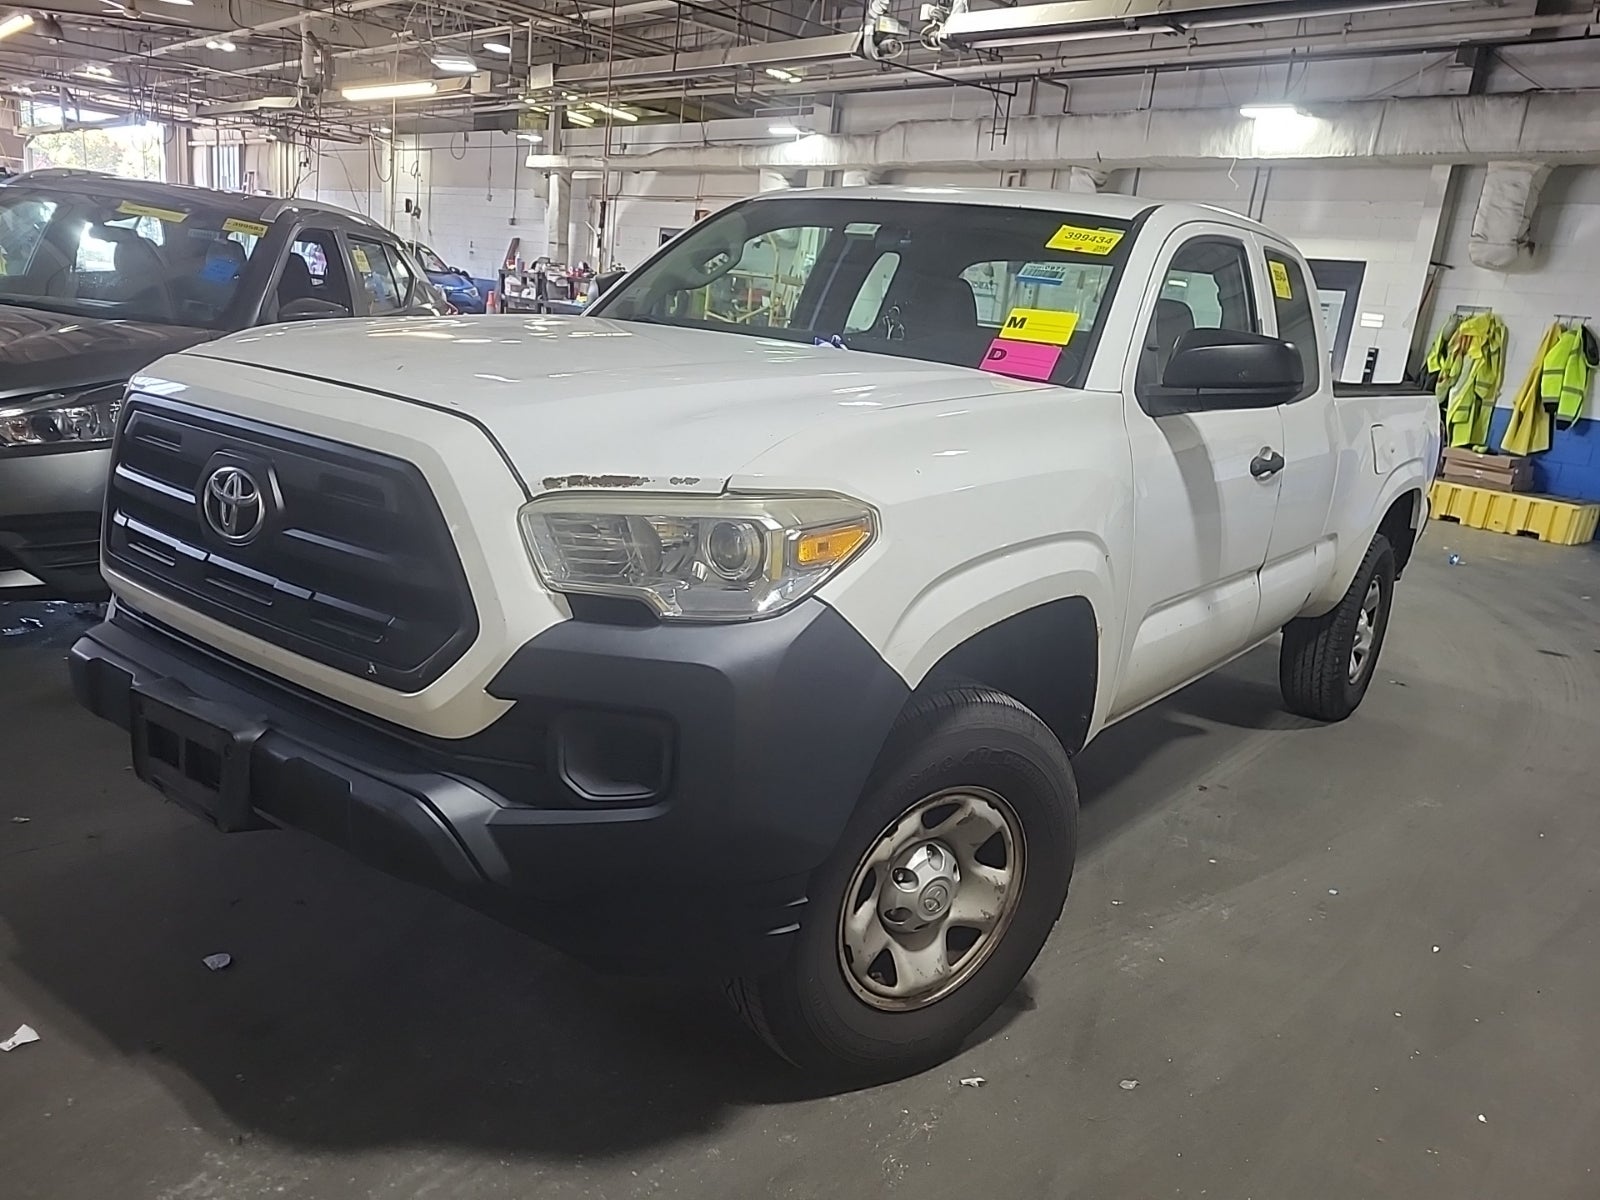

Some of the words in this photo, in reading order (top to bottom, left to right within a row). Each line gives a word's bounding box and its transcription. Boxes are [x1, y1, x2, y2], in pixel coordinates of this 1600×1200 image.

[1065, 231, 1114, 245] 399434
[1006, 316, 1028, 329] M
[987, 347, 1007, 361] D
